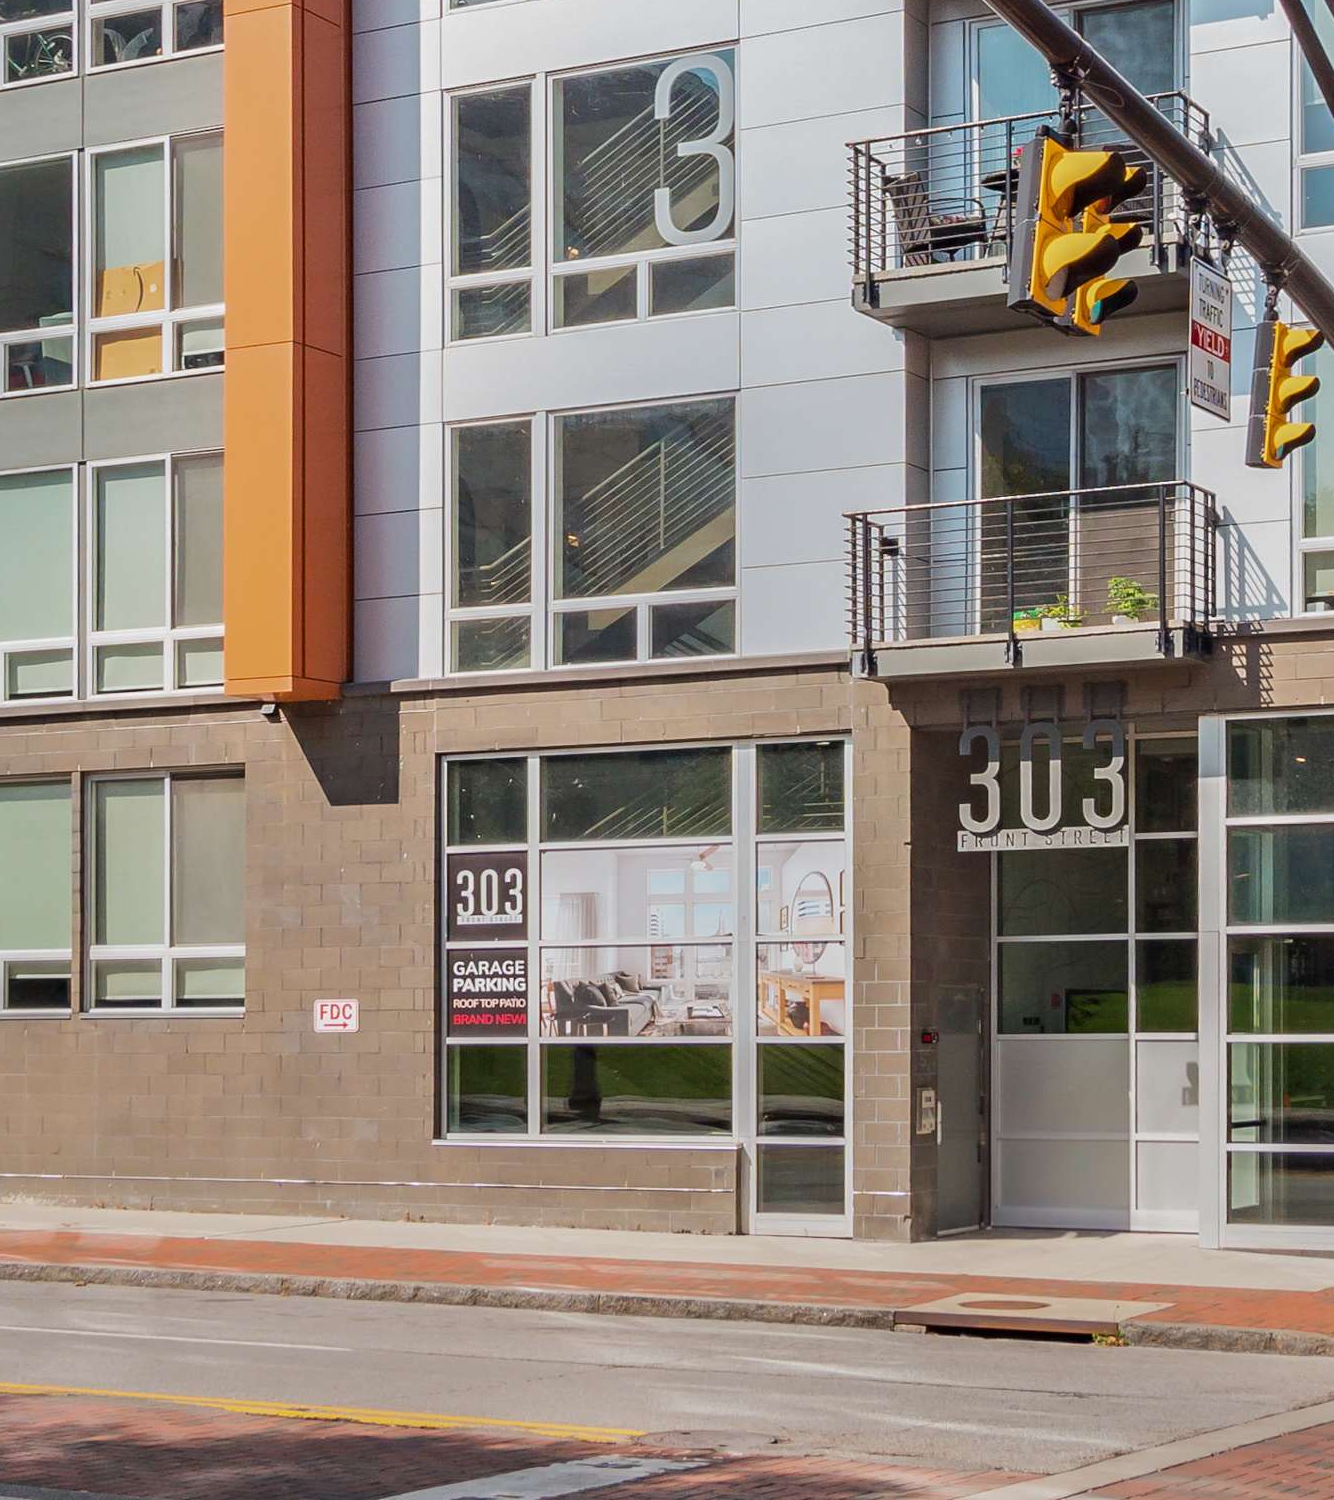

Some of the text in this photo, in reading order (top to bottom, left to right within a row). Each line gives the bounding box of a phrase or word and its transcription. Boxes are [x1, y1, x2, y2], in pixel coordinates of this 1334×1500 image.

[1199, 273, 1225, 304] TURNING
[1199, 298, 1223, 328] TRAFFIC
[1197, 327, 1224, 357] YIELD
[1207, 360, 1214, 380] TO
[1194, 378, 1227, 411] PEDESTRIANS
[959, 719, 1124, 833] 303
[961, 829, 1125, 848] FRONT STREET
[456, 868, 523, 916] 303
[453, 960, 524, 976] GARAGE
[453, 977, 526, 992] PARKING
[320, 1004, 352, 1020] FDC
[500, 997, 526, 1008] PATIO
[453, 1014, 494, 1025] BRAND
